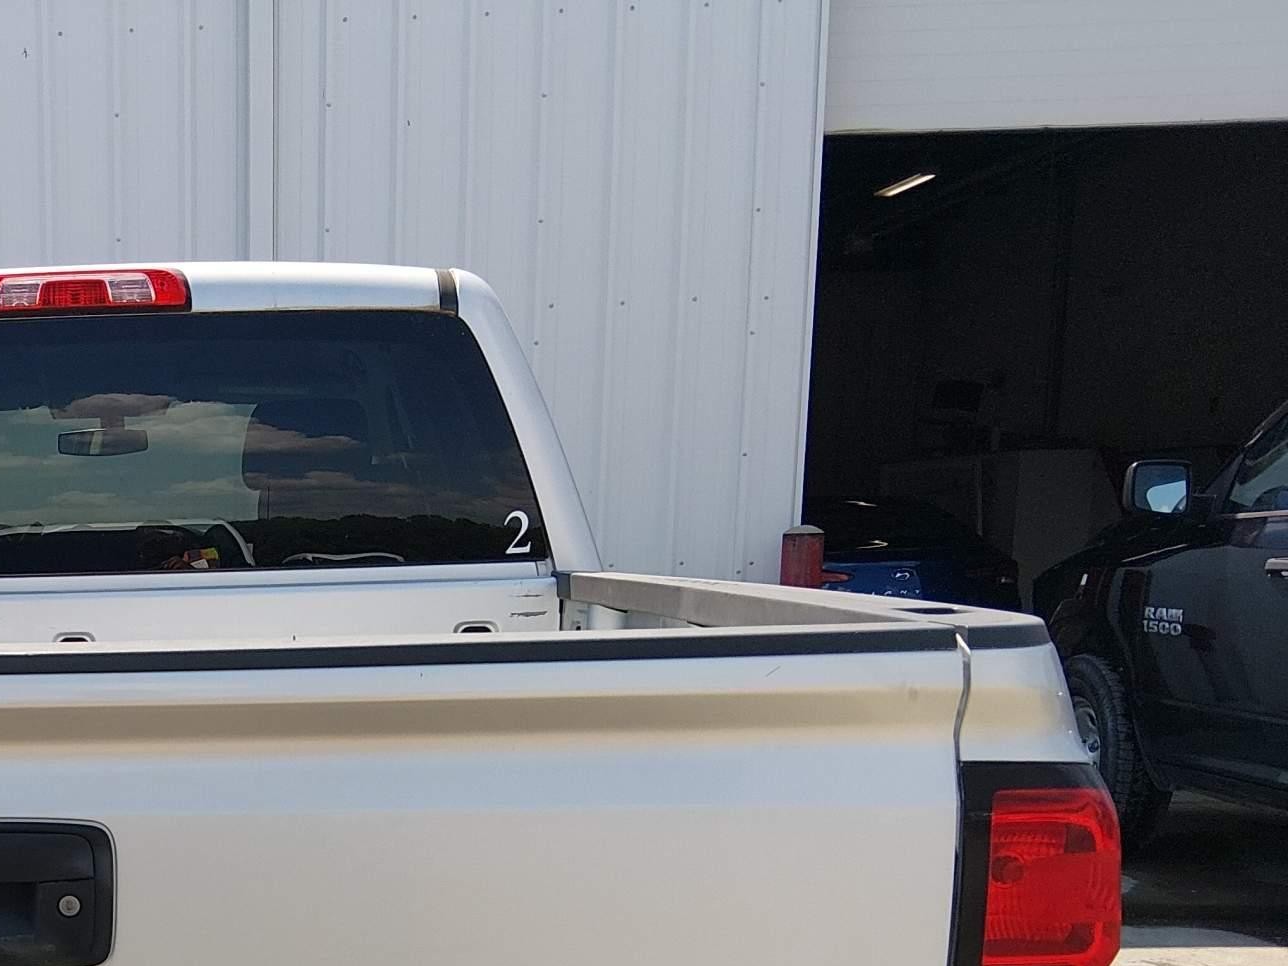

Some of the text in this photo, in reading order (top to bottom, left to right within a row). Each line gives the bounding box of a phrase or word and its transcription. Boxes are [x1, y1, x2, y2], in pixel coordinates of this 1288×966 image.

[503, 510, 532, 554] 2
[1144, 606, 1184, 622] RAM
[1142, 619, 1182, 636] 1500
